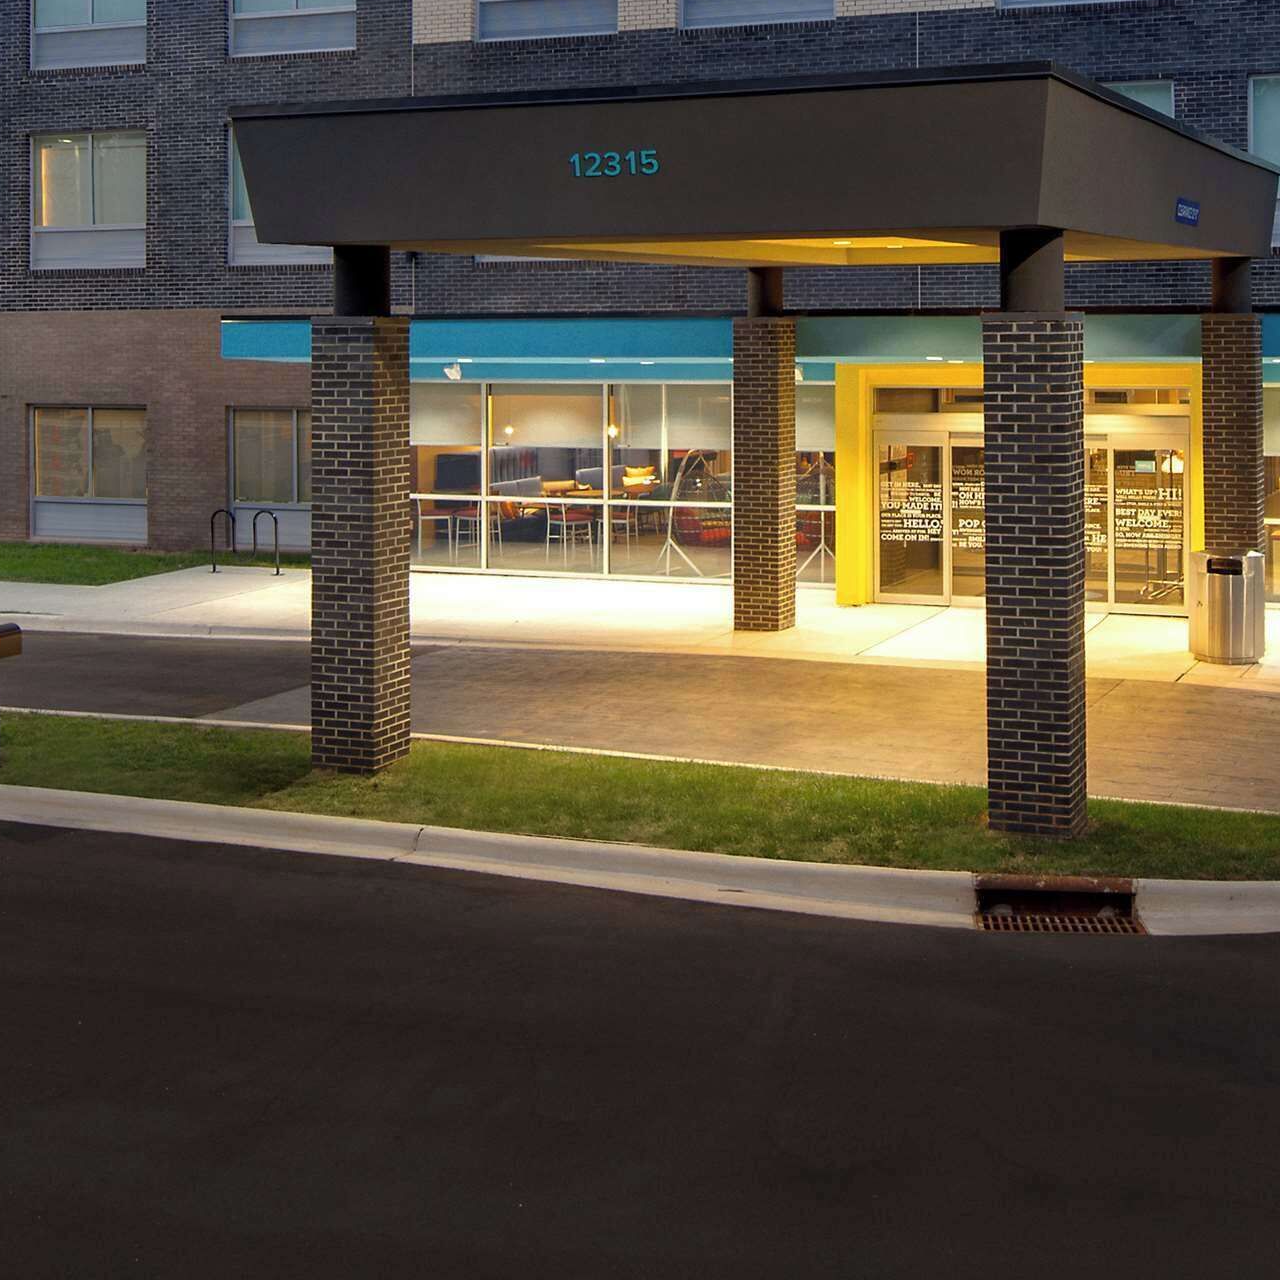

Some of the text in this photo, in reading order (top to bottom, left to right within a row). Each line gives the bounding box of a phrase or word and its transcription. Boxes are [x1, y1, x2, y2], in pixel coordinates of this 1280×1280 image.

[570, 149, 660, 177] 12315
[1158, 487, 1182, 500] HI!
[902, 502, 930, 510] MADE
[1115, 508, 1136, 516] BEST
